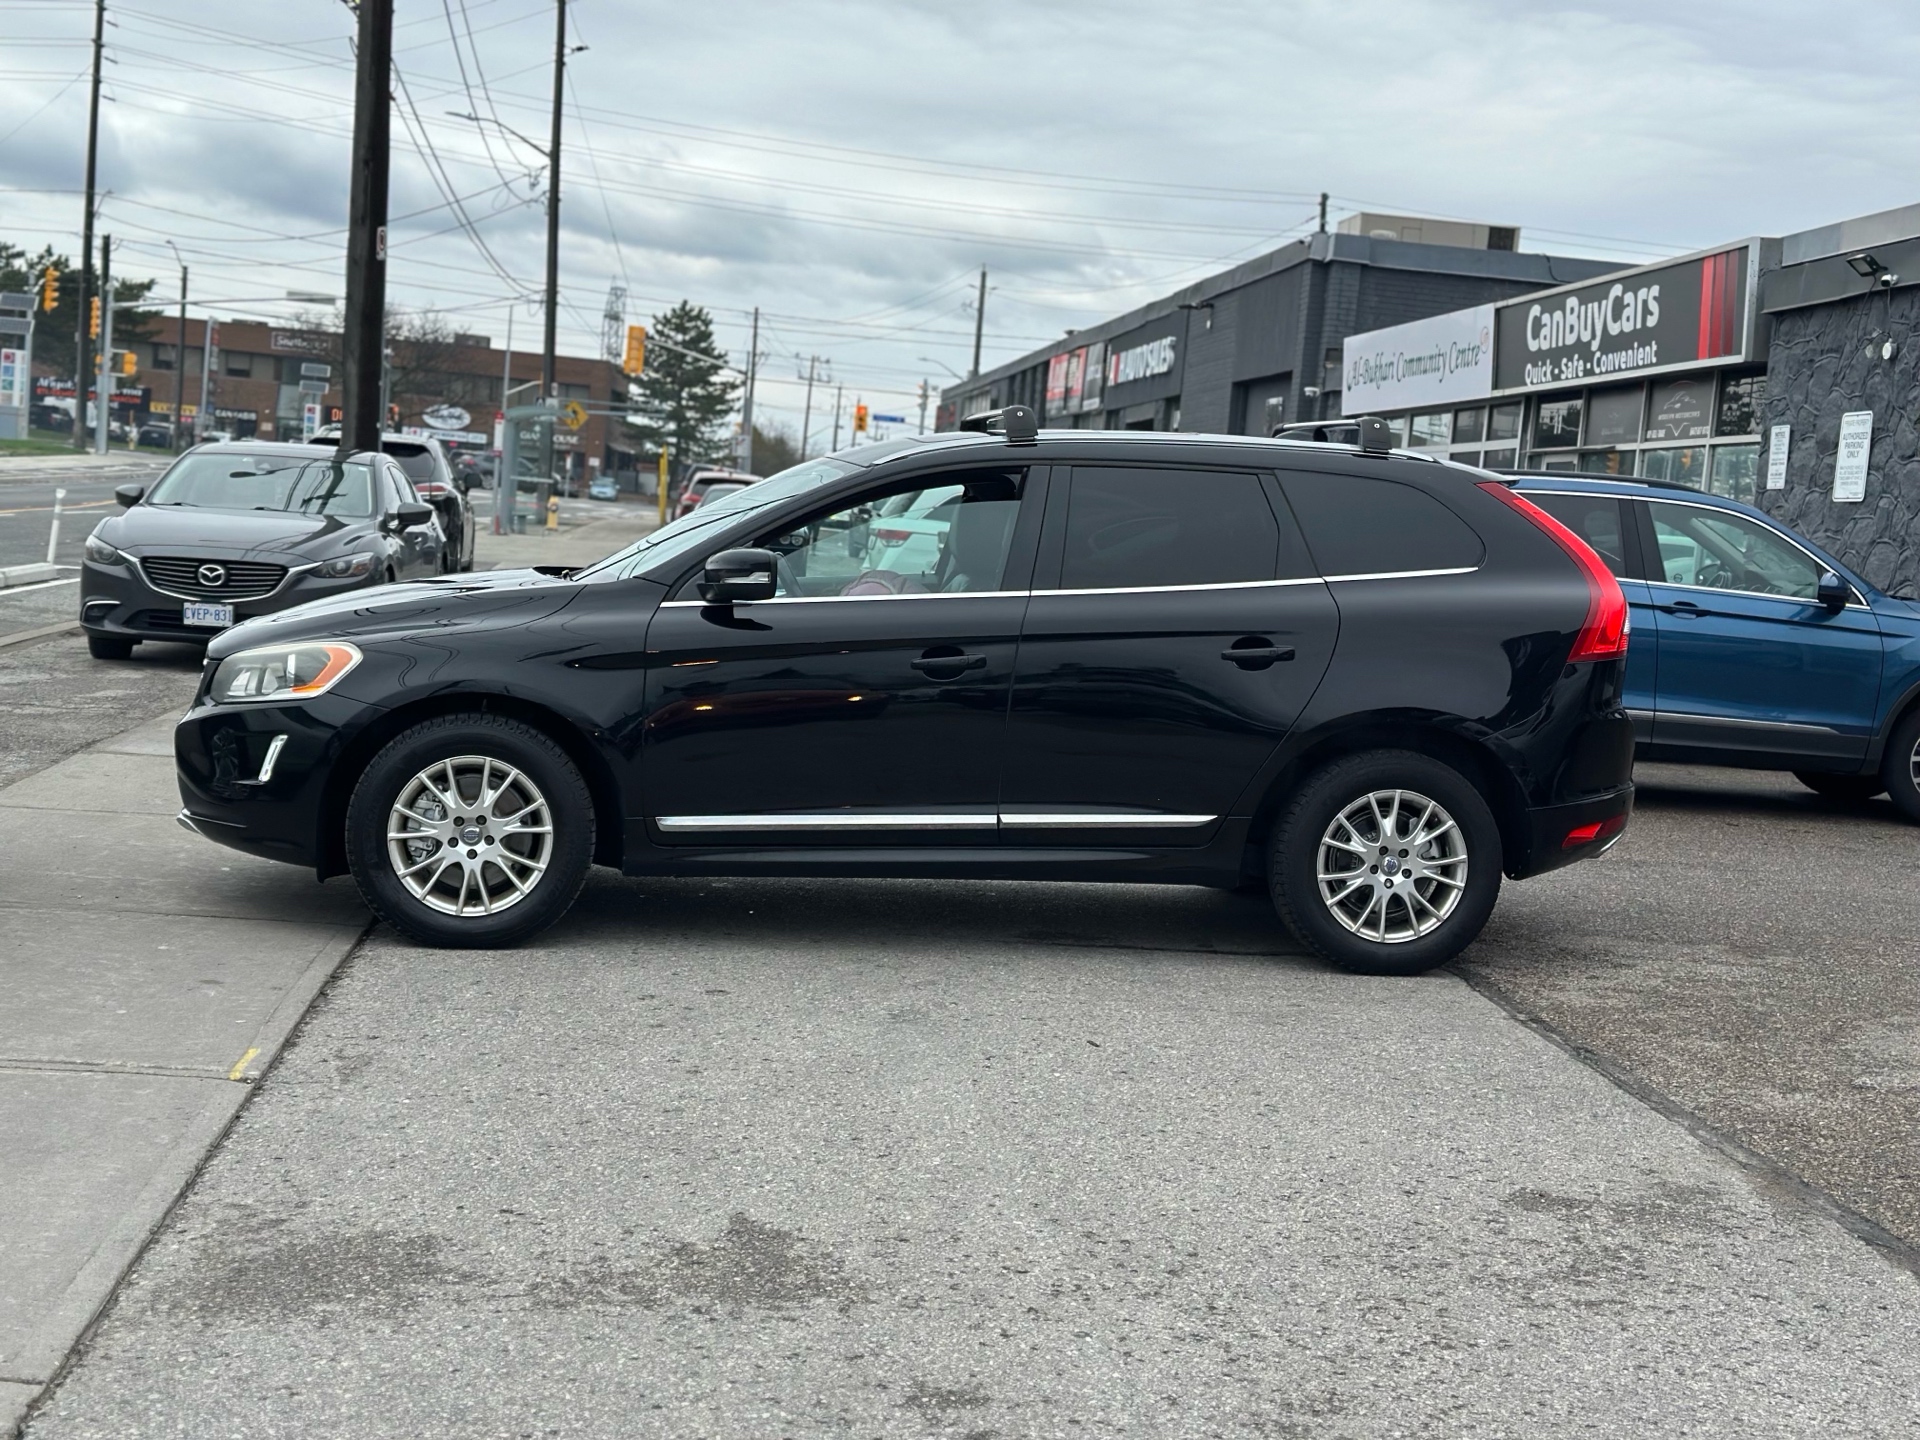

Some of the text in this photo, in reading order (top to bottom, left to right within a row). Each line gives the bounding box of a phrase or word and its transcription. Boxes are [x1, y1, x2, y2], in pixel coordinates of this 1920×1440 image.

[1526, 283, 1660, 352] CanBuyCars
[1346, 341, 1481, 392] Al-Bukhari Community Centre
[1525, 358, 1553, 387] Quick
[1560, 354, 1584, 380] Safe
[1593, 340, 1657, 374] Convenient
[1843, 432, 1868, 441] AUTHORIZED
[1845, 441, 1864, 449] PARKING
[1846, 450, 1860, 458] ONLY
